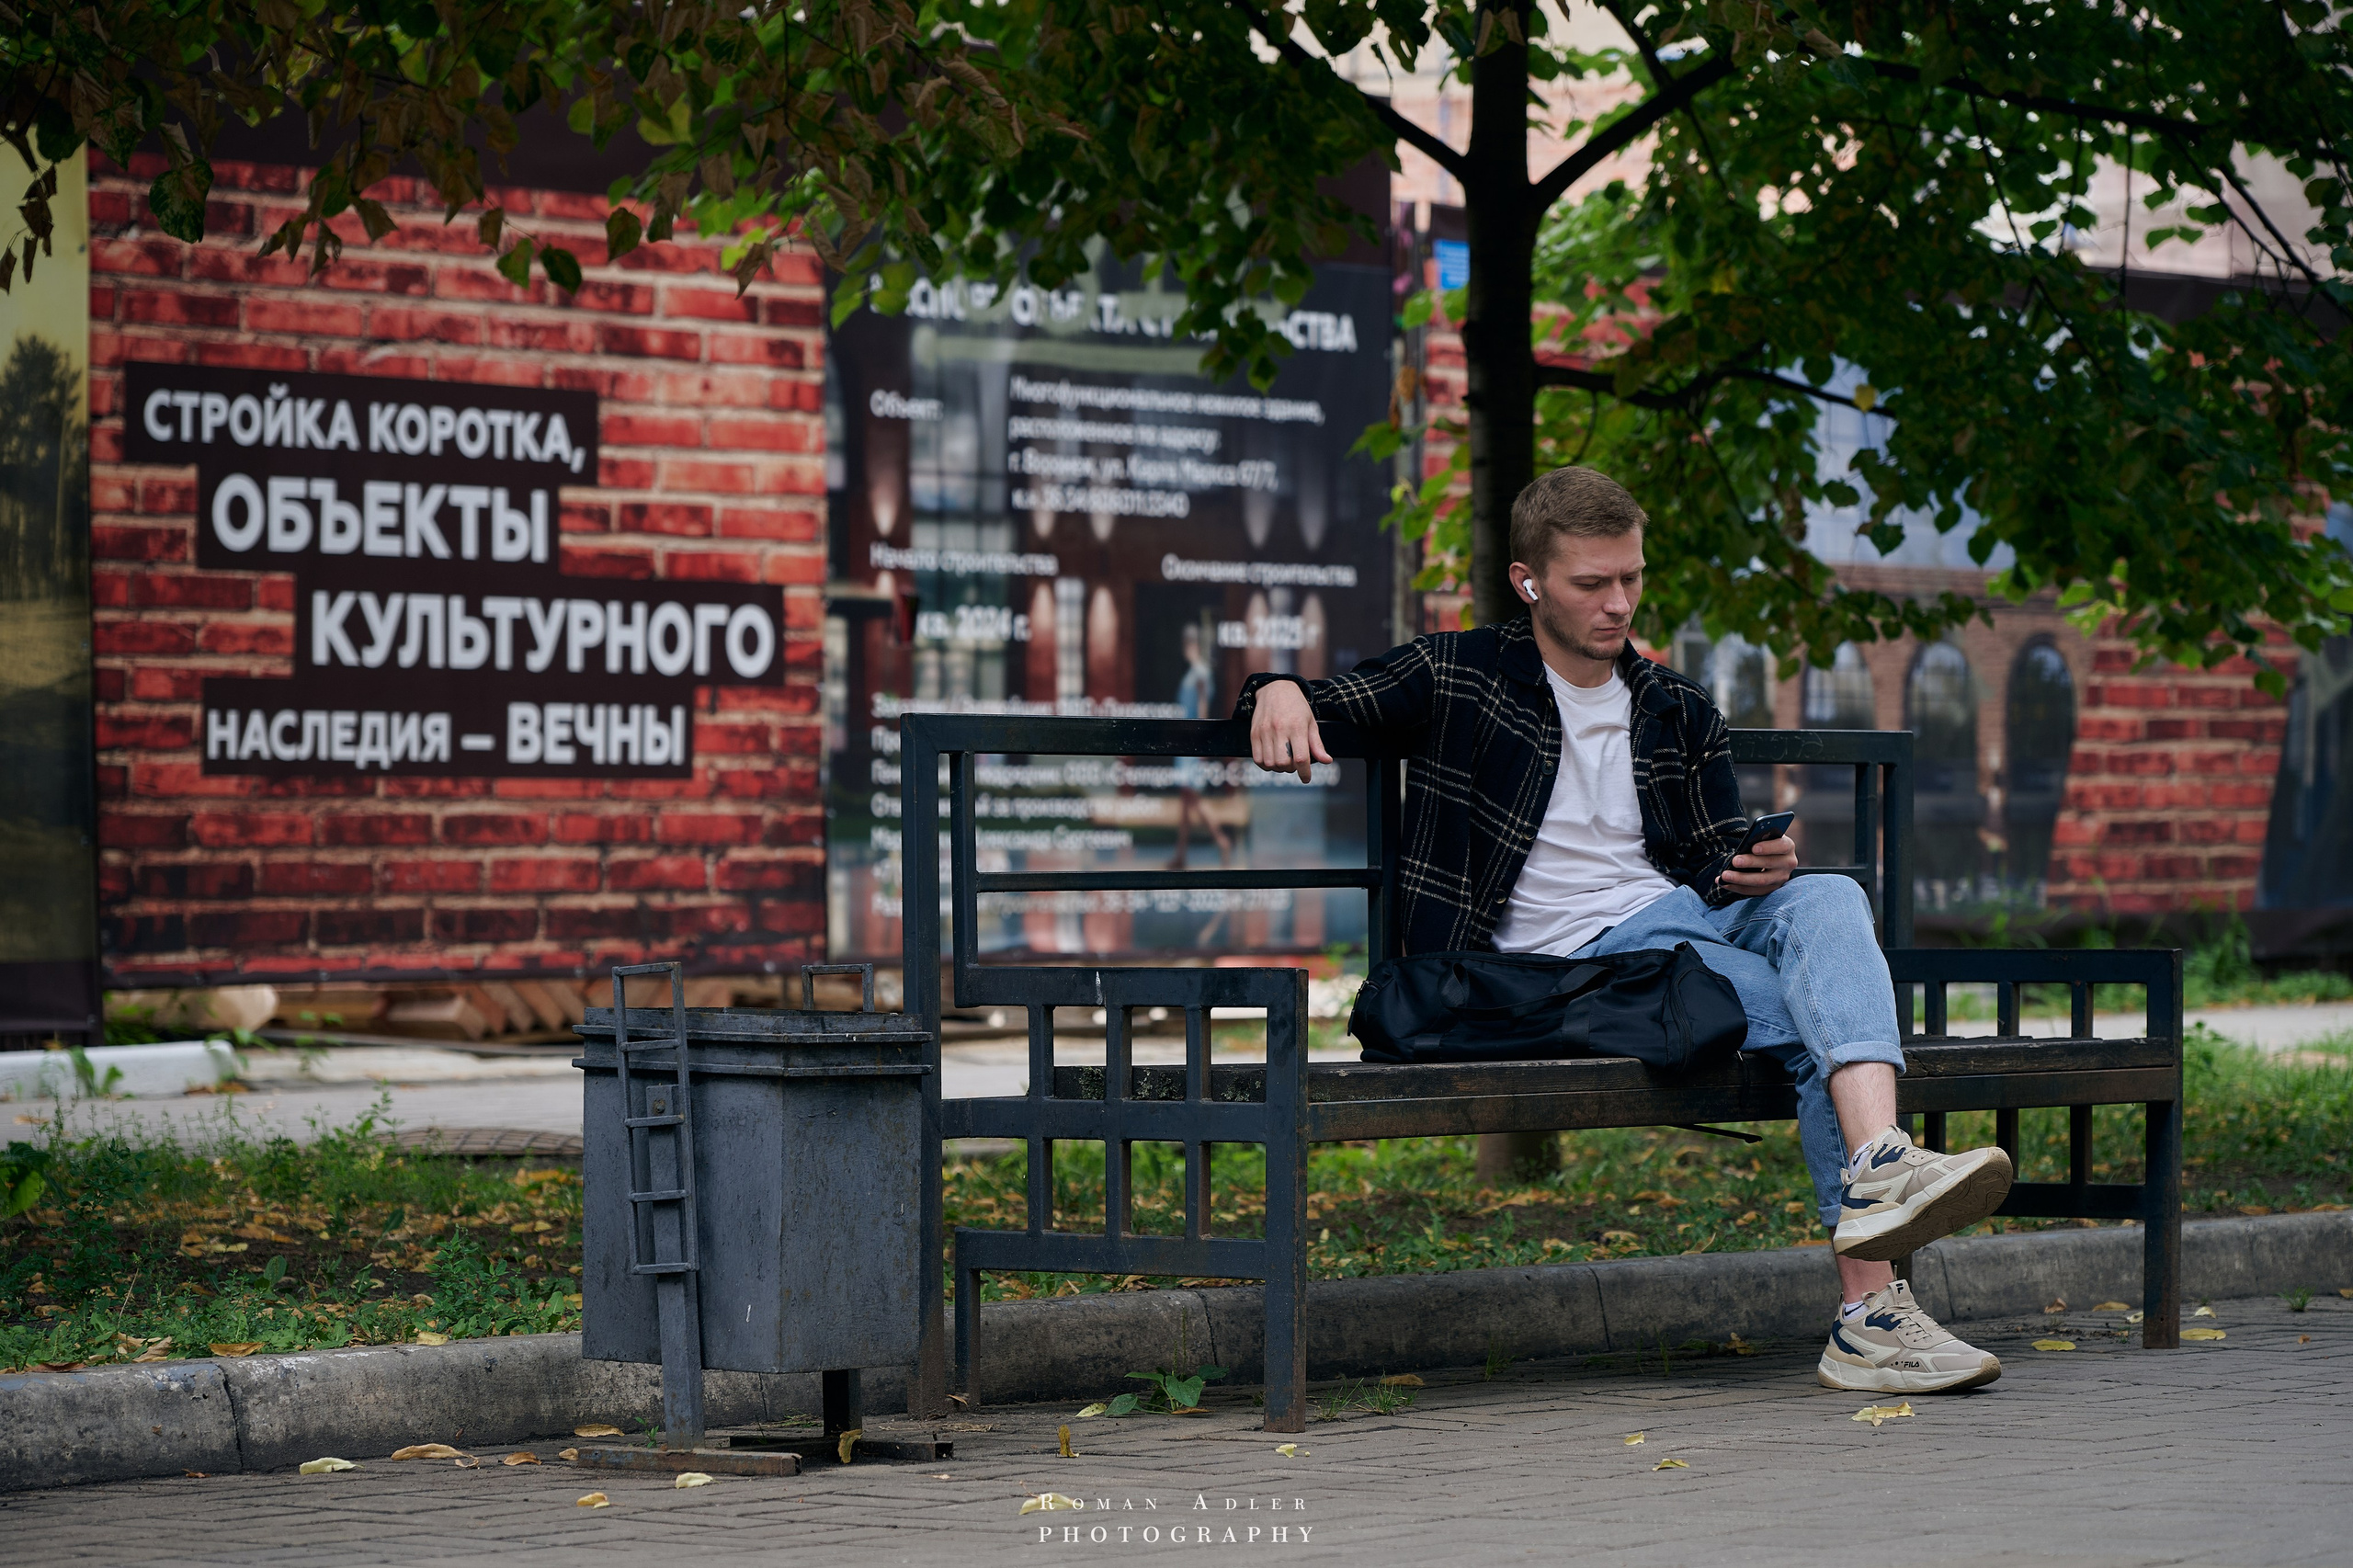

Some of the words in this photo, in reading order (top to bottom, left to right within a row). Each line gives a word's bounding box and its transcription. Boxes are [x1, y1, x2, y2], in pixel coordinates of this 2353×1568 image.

[143, 382, 360, 451] СТРОЙКА
[369, 403, 587, 472] КОРОТКА,
[211, 473, 550, 563] ОБЪЕКТЫ
[311, 589, 777, 679] КУЛЬТУРНОГО
[207, 707, 451, 770] НАСЛЕДИЯ
[506, 701, 686, 765] ВЕЧНЫ
[1904, 1360, 1920, 1369] FILA
